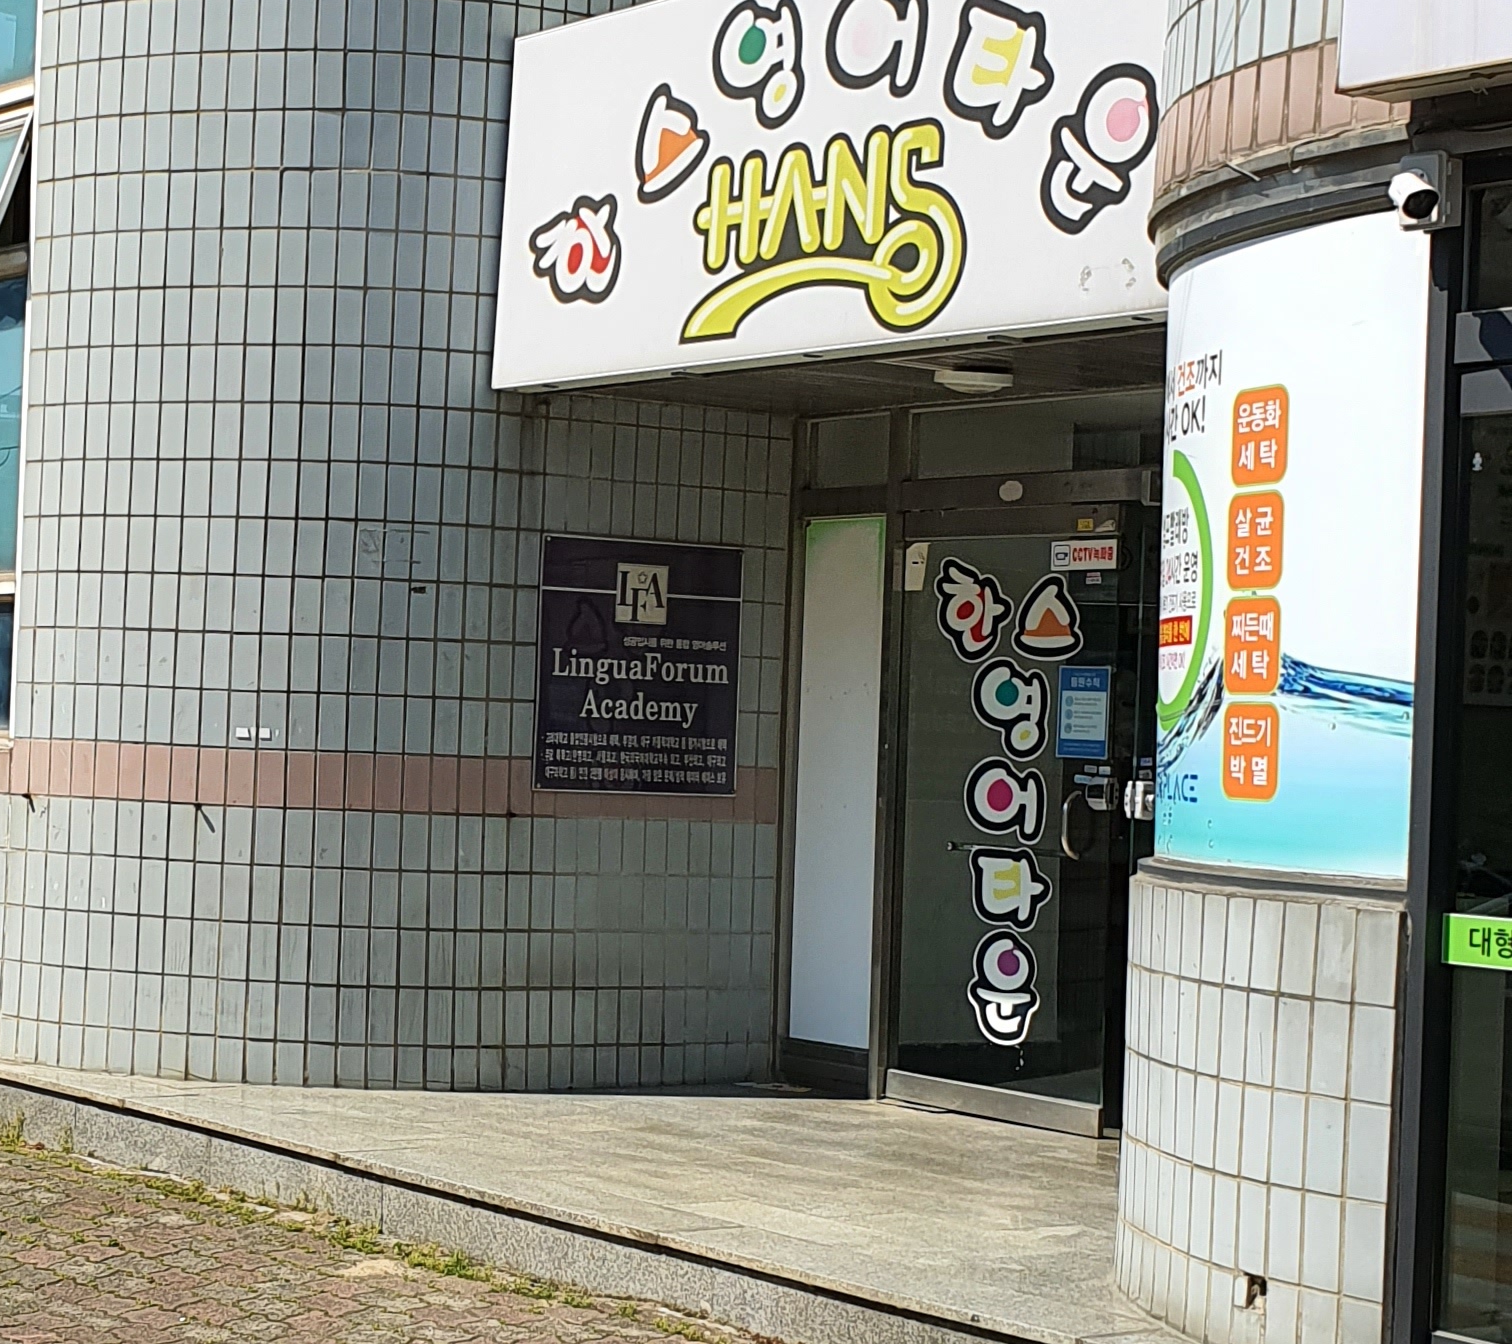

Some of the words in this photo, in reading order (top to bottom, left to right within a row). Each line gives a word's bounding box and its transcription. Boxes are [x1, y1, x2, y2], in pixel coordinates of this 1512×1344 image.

[680, 118, 966, 345] HANS
[1177, 349, 1223, 397] 건조까지
[1181, 395, 1206, 434] OK!
[1238, 399, 1282, 433] 운동화
[1238, 438, 1277, 471] 세탁
[1235, 506, 1273, 537] 살균
[1234, 546, 1272, 575] 건조
[1231, 611, 1274, 642] 찌든때
[552, 647, 729, 685] LinguaForum
[1231, 650, 1269, 679] 세탁
[579, 689, 698, 729] Academy
[1229, 717, 1271, 747] 진드기
[1229, 756, 1268, 785] 박멸
